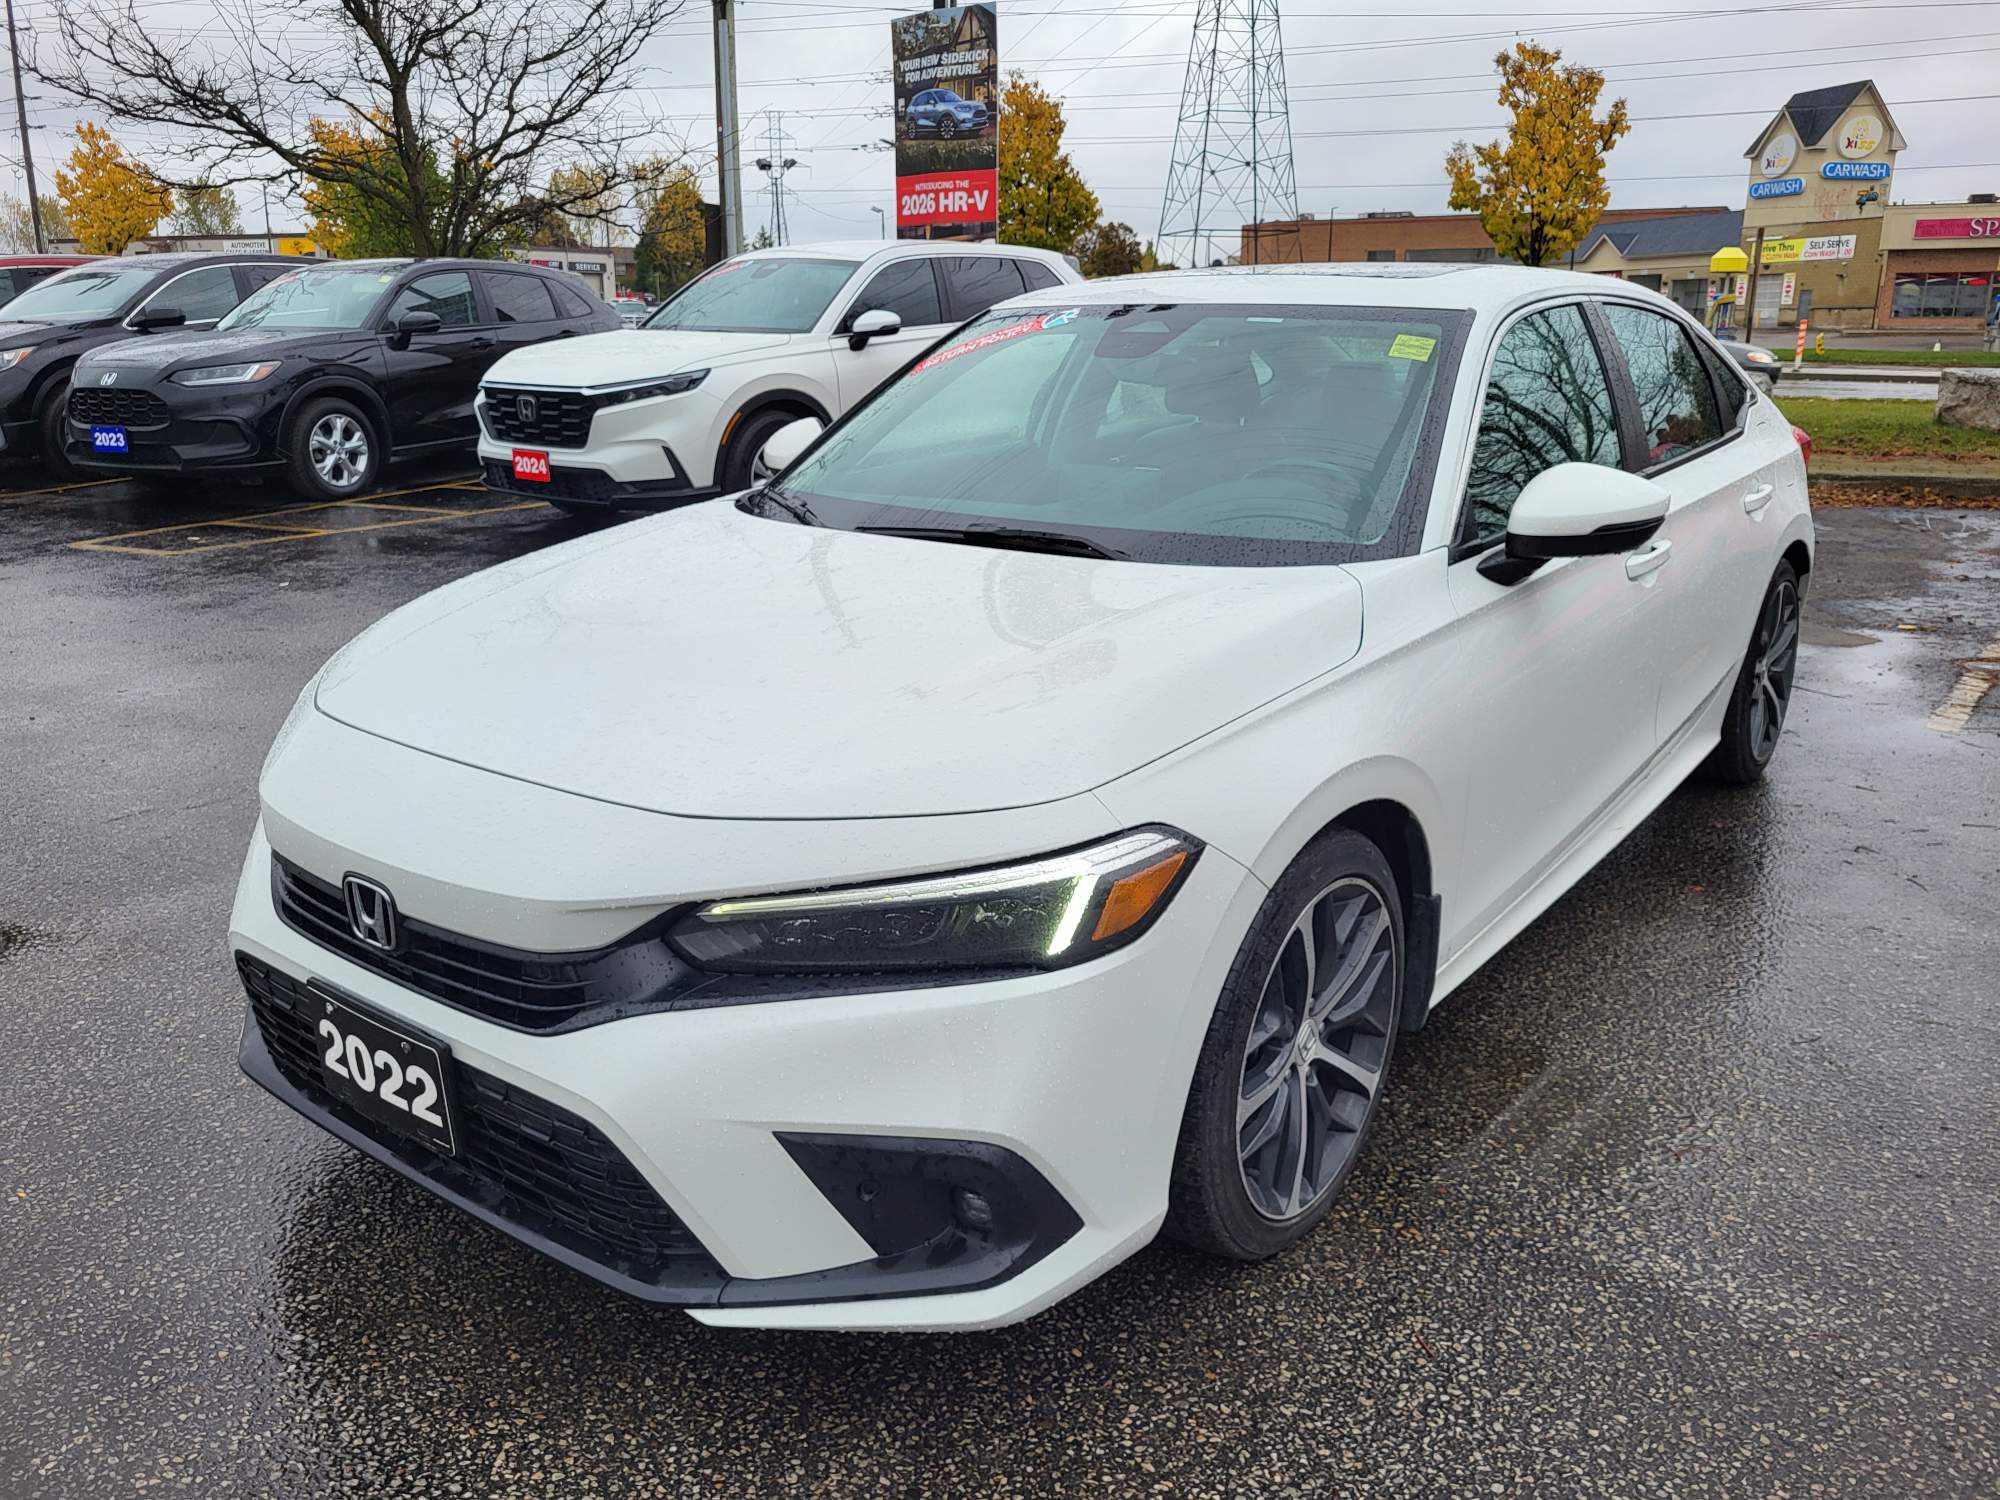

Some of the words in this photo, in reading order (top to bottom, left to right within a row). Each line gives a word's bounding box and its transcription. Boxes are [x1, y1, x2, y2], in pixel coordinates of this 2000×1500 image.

[899, 57, 921, 72] YOUR
[921, 54, 941, 68] NEW
[941, 48, 990, 65] SIDEKICK
[905, 71, 921, 83] FOR
[921, 63, 982, 81] ADVENTURE.
[1826, 163, 1887, 177] CARWASH
[915, 181, 954, 191] INTRODUCING
[955, 180, 969, 188] THE
[1751, 180, 1800, 197] CARWASH
[902, 192, 936, 216] 2026
[938, 190, 989, 213] HR-V
[1969, 218, 2000, 238] SP
[231, 241, 266, 249] AUTOMOTIVE
[1762, 244, 1776, 253] rive
[1778, 243, 1795, 252] Thru
[1809, 240, 1825, 249] SELF
[575, 263, 601, 271] SERVICE
[94, 432, 125, 447] 2023
[515, 455, 547, 474] 2024
[319, 1018, 443, 1128] 2022
